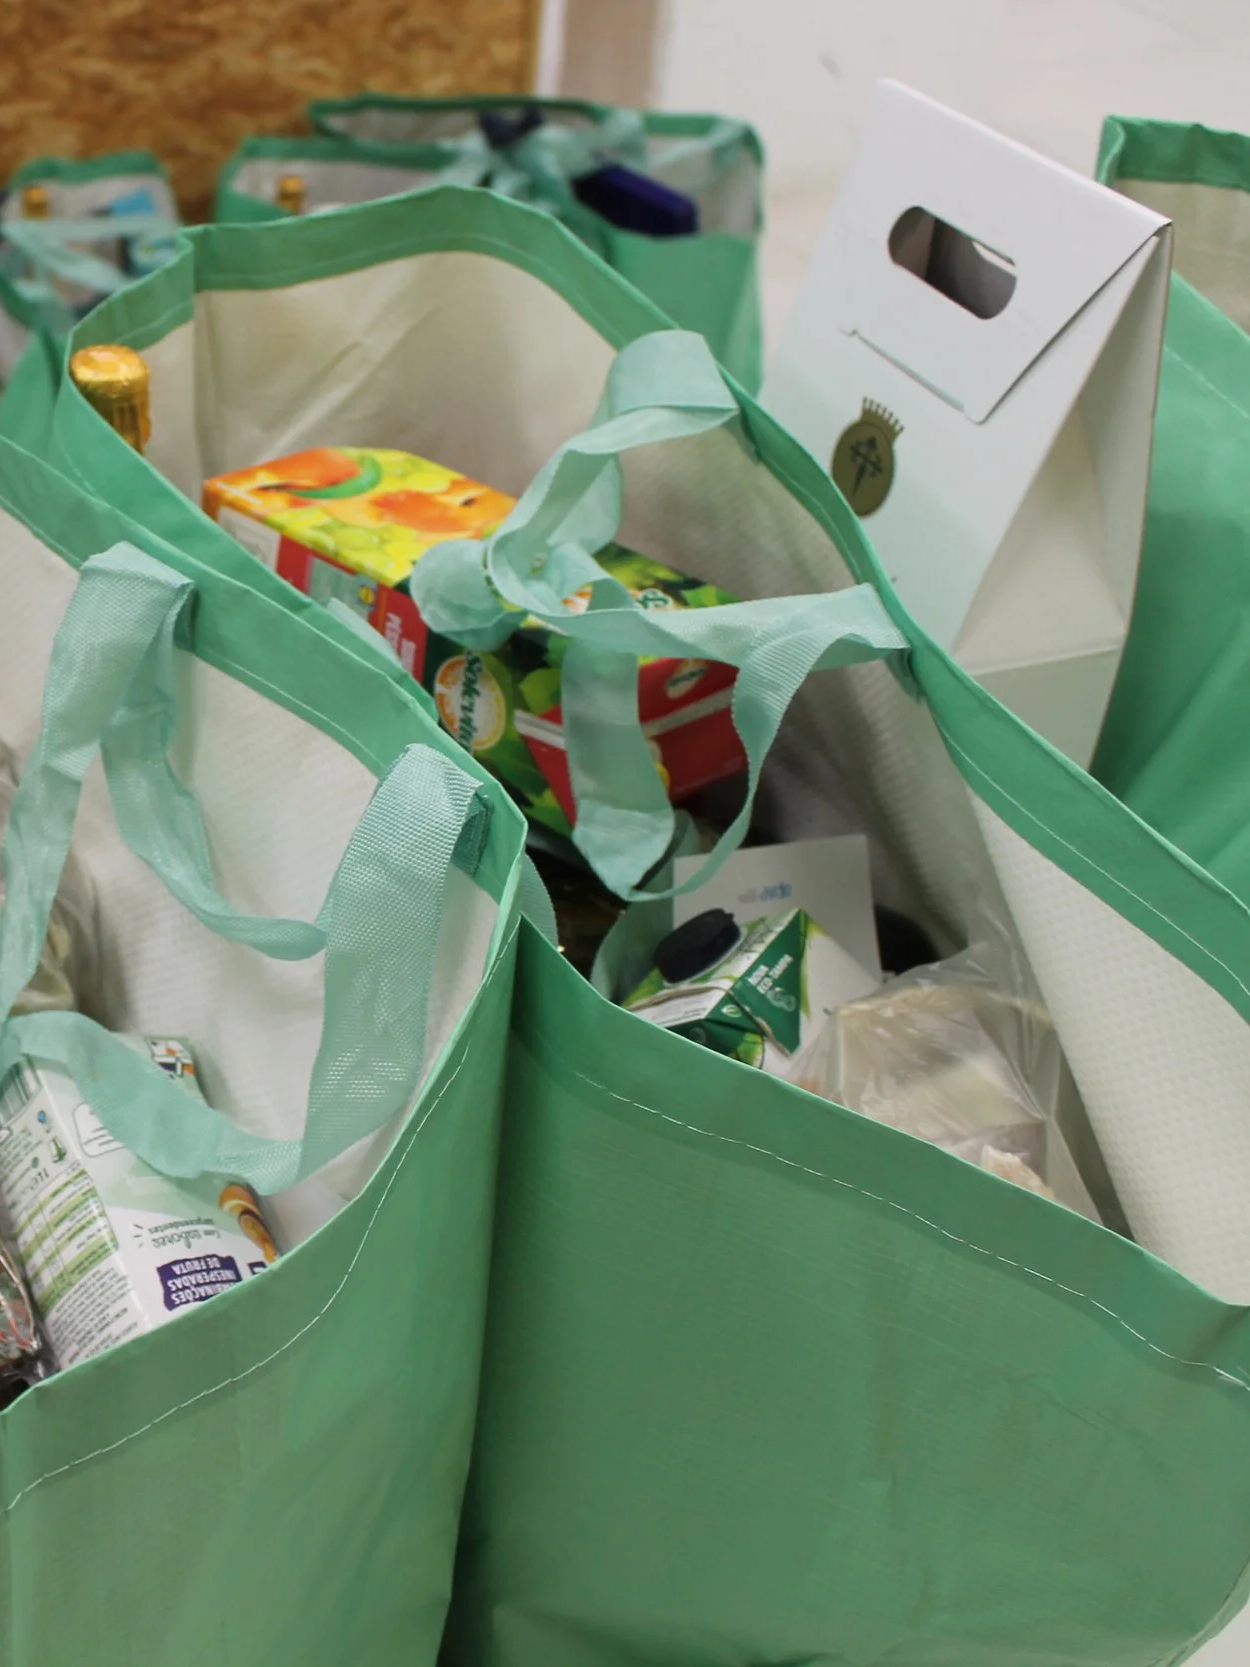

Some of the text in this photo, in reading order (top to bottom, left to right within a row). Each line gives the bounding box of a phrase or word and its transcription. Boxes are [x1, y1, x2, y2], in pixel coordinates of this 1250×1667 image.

[150, 1229, 201, 1249] sabores
[170, 1256, 221, 1275] DE FRUTA
